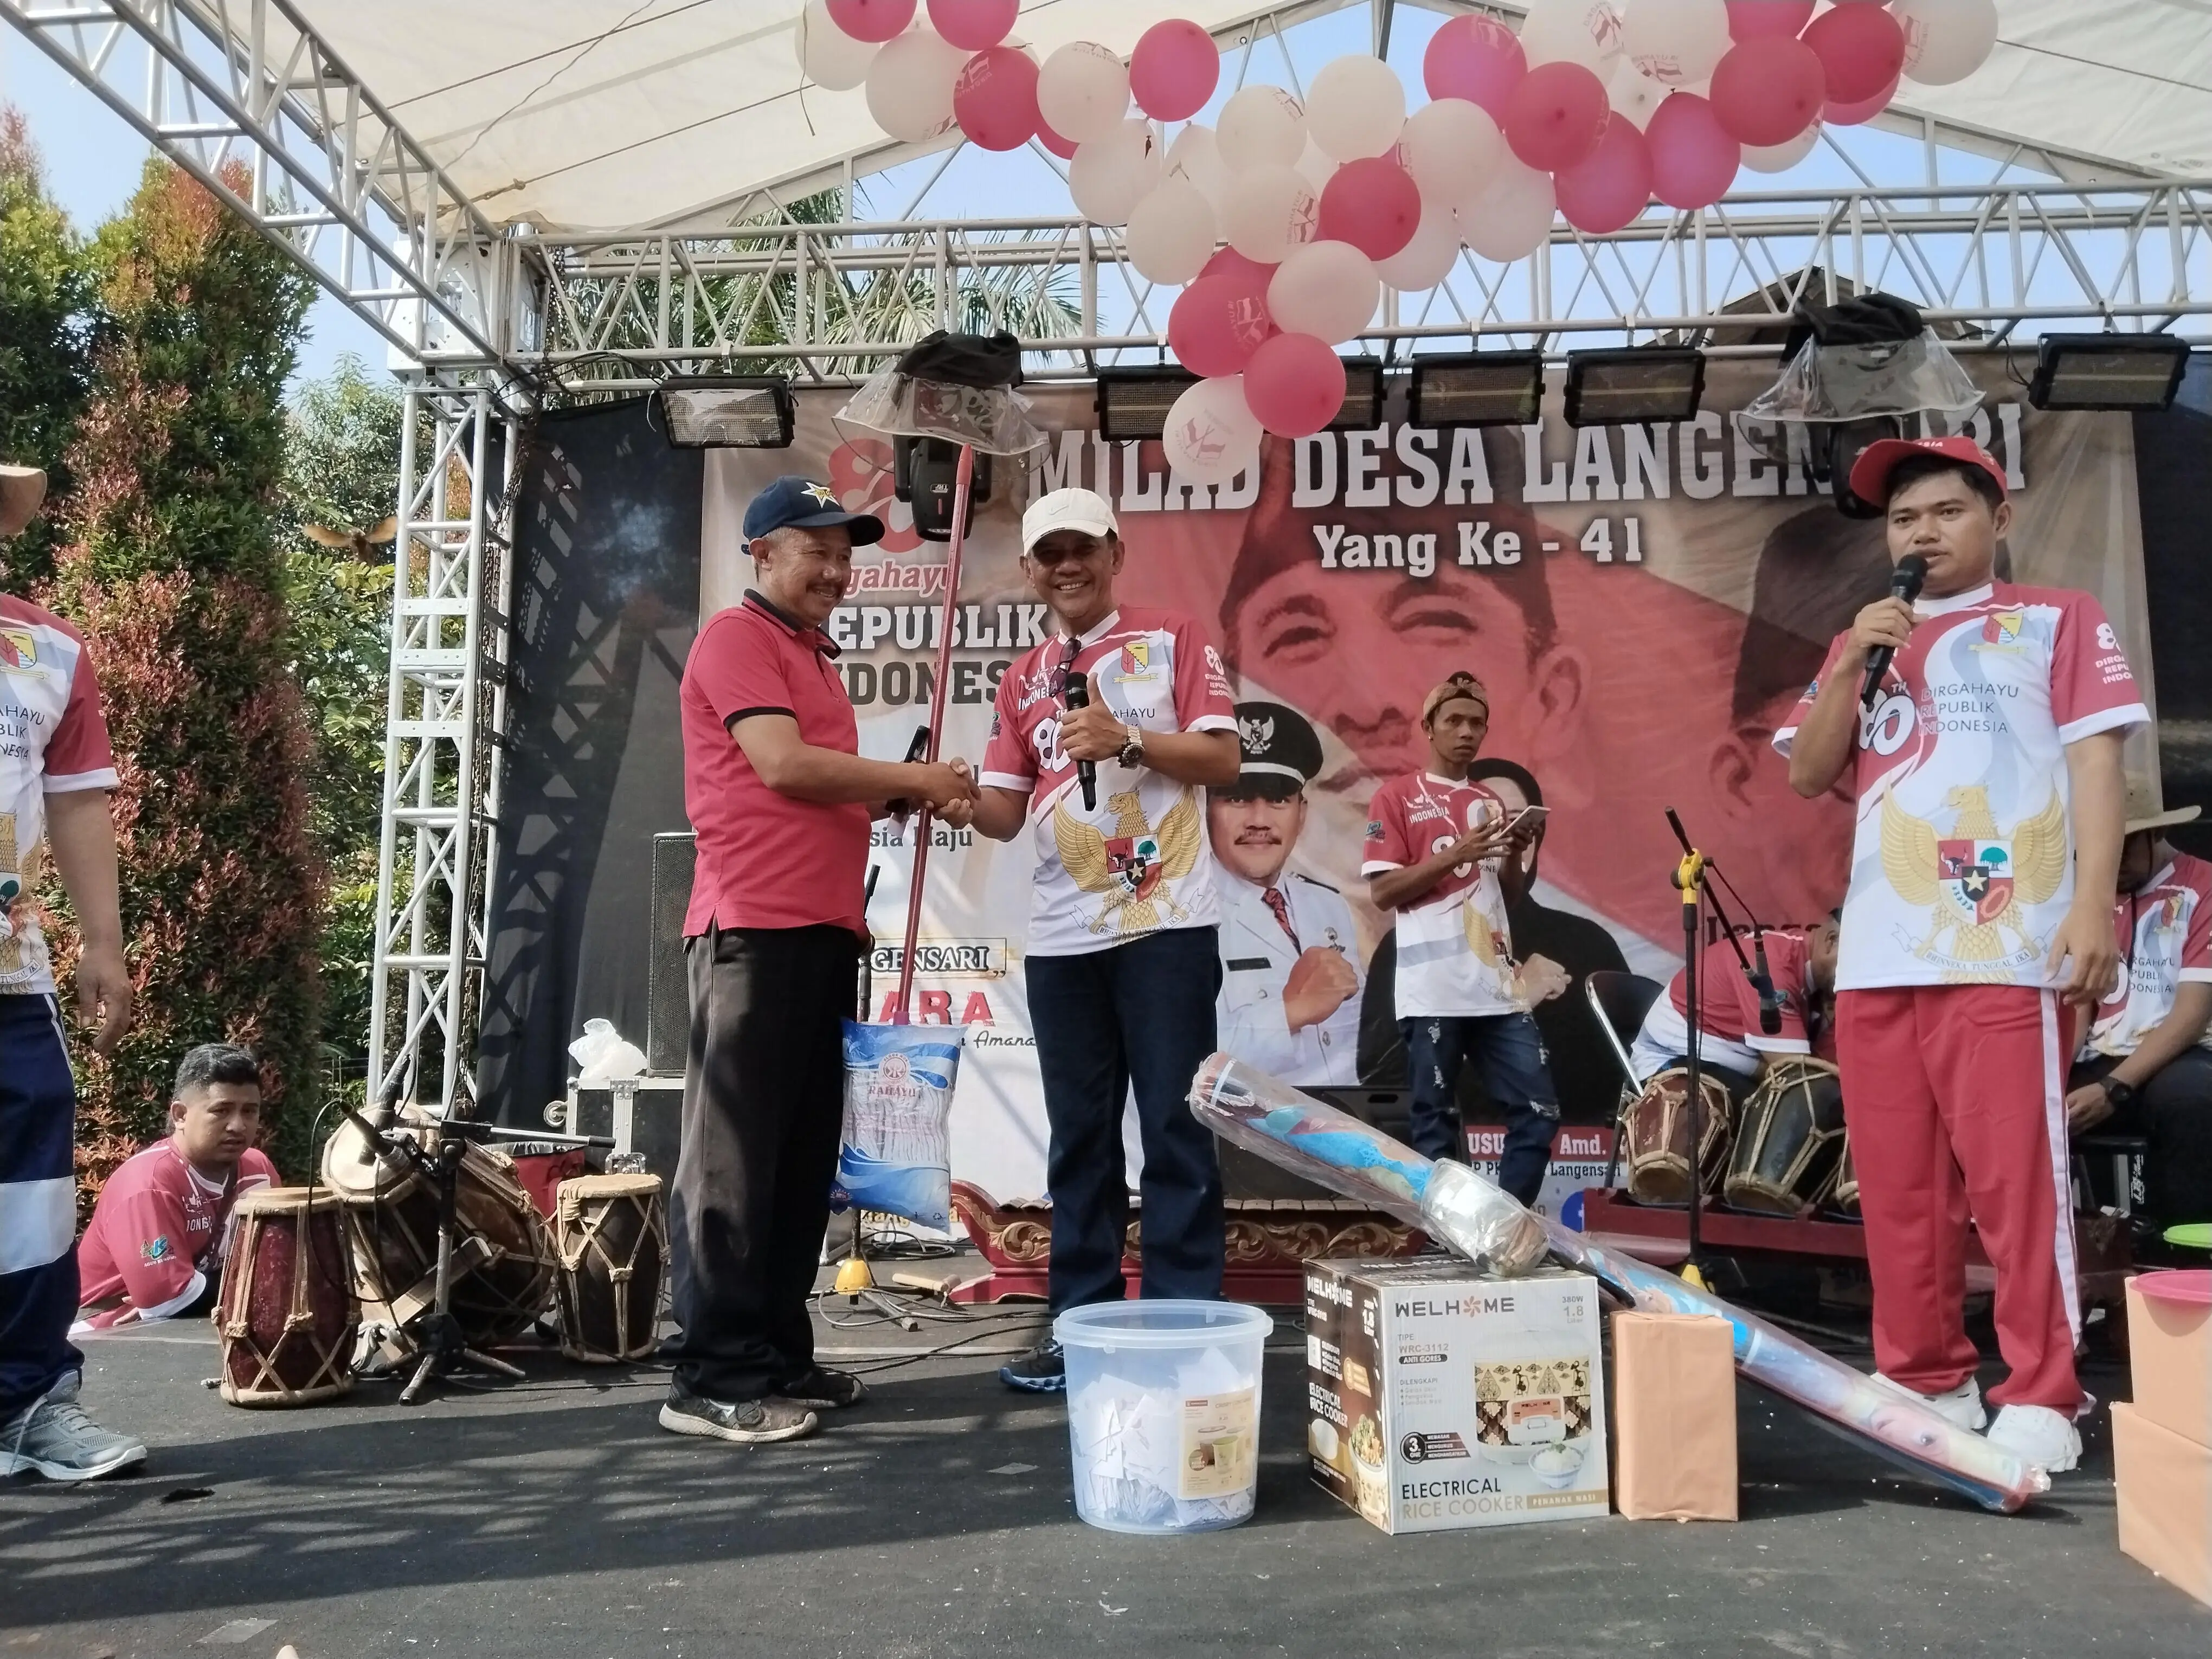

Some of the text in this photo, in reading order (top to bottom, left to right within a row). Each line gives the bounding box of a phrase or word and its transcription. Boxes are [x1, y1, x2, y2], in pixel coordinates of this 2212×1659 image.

[1292, 423, 1493, 509] DESA
[1313, 524, 1438, 577] Yang
[1458, 521, 1522, 565] Ke
[1579, 517, 1643, 563] 41
[1921, 683, 2019, 702] DIRGAHAYU
[1920, 702, 1995, 718] REPUBLIK
[1918, 719, 2009, 737] INDONESIA
[1409, 806, 1450, 824] INDONESIA
[1559, 1134, 1606, 1155] Amd.
[1563, 1305, 1584, 1317] 1.8
[1399, 1343, 1449, 1354] WRC-3112
[1401, 1477, 1502, 1500] ELECTRICAL
[1402, 1501, 1442, 1520] RICE
[1448, 1495, 1523, 1516] COOKER
